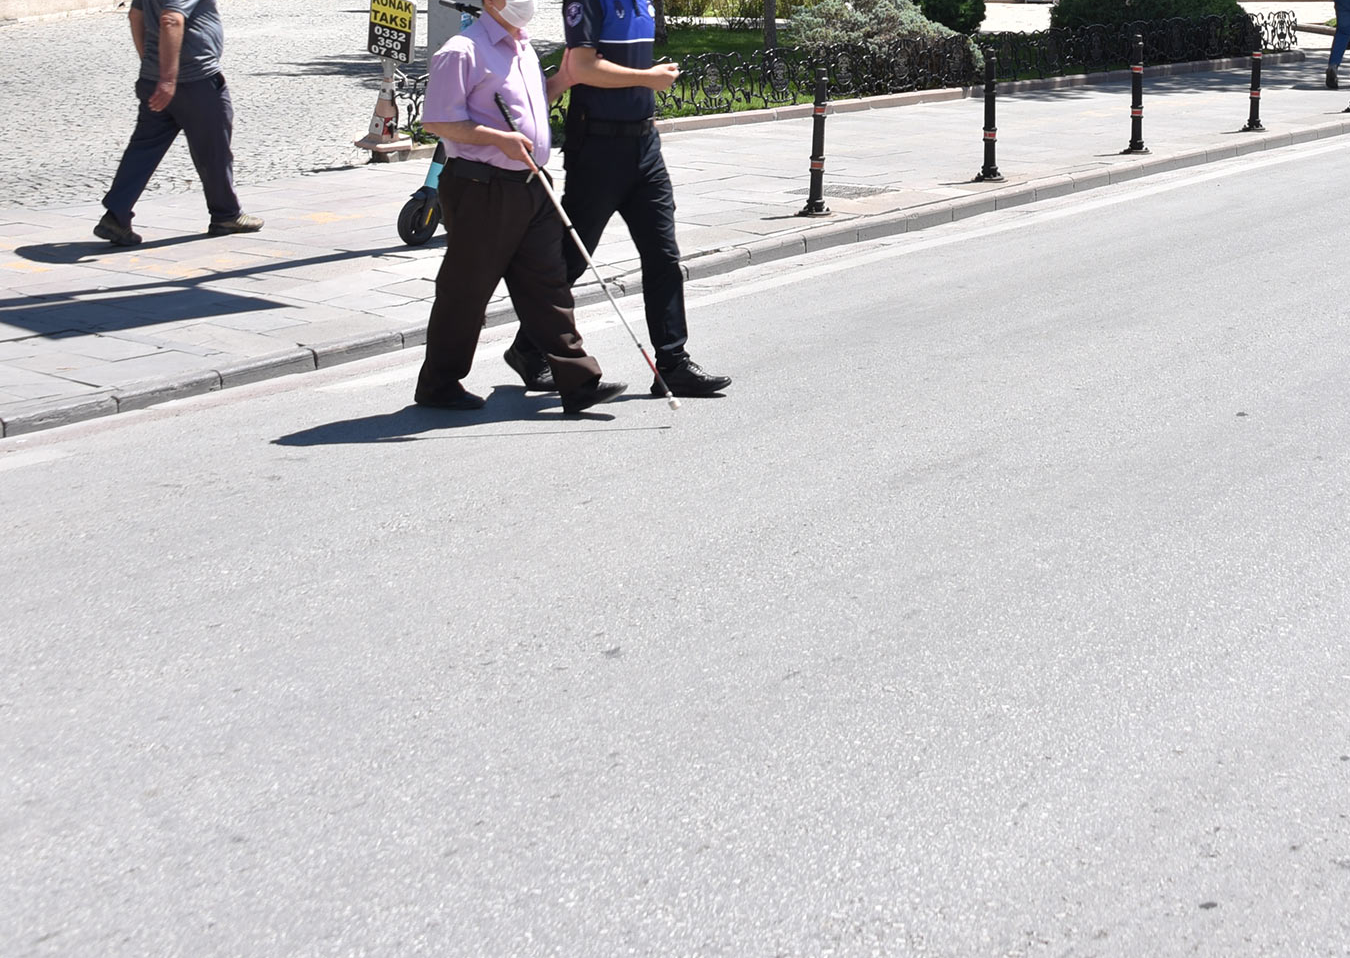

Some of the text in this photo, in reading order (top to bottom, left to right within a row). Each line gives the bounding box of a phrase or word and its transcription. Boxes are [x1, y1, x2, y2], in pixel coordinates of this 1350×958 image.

[371, 9, 412, 30] TAKSİ
[374, 26, 406, 42] 0332
[377, 37, 401, 51] 350
[371, 44, 407, 61] 07 36
